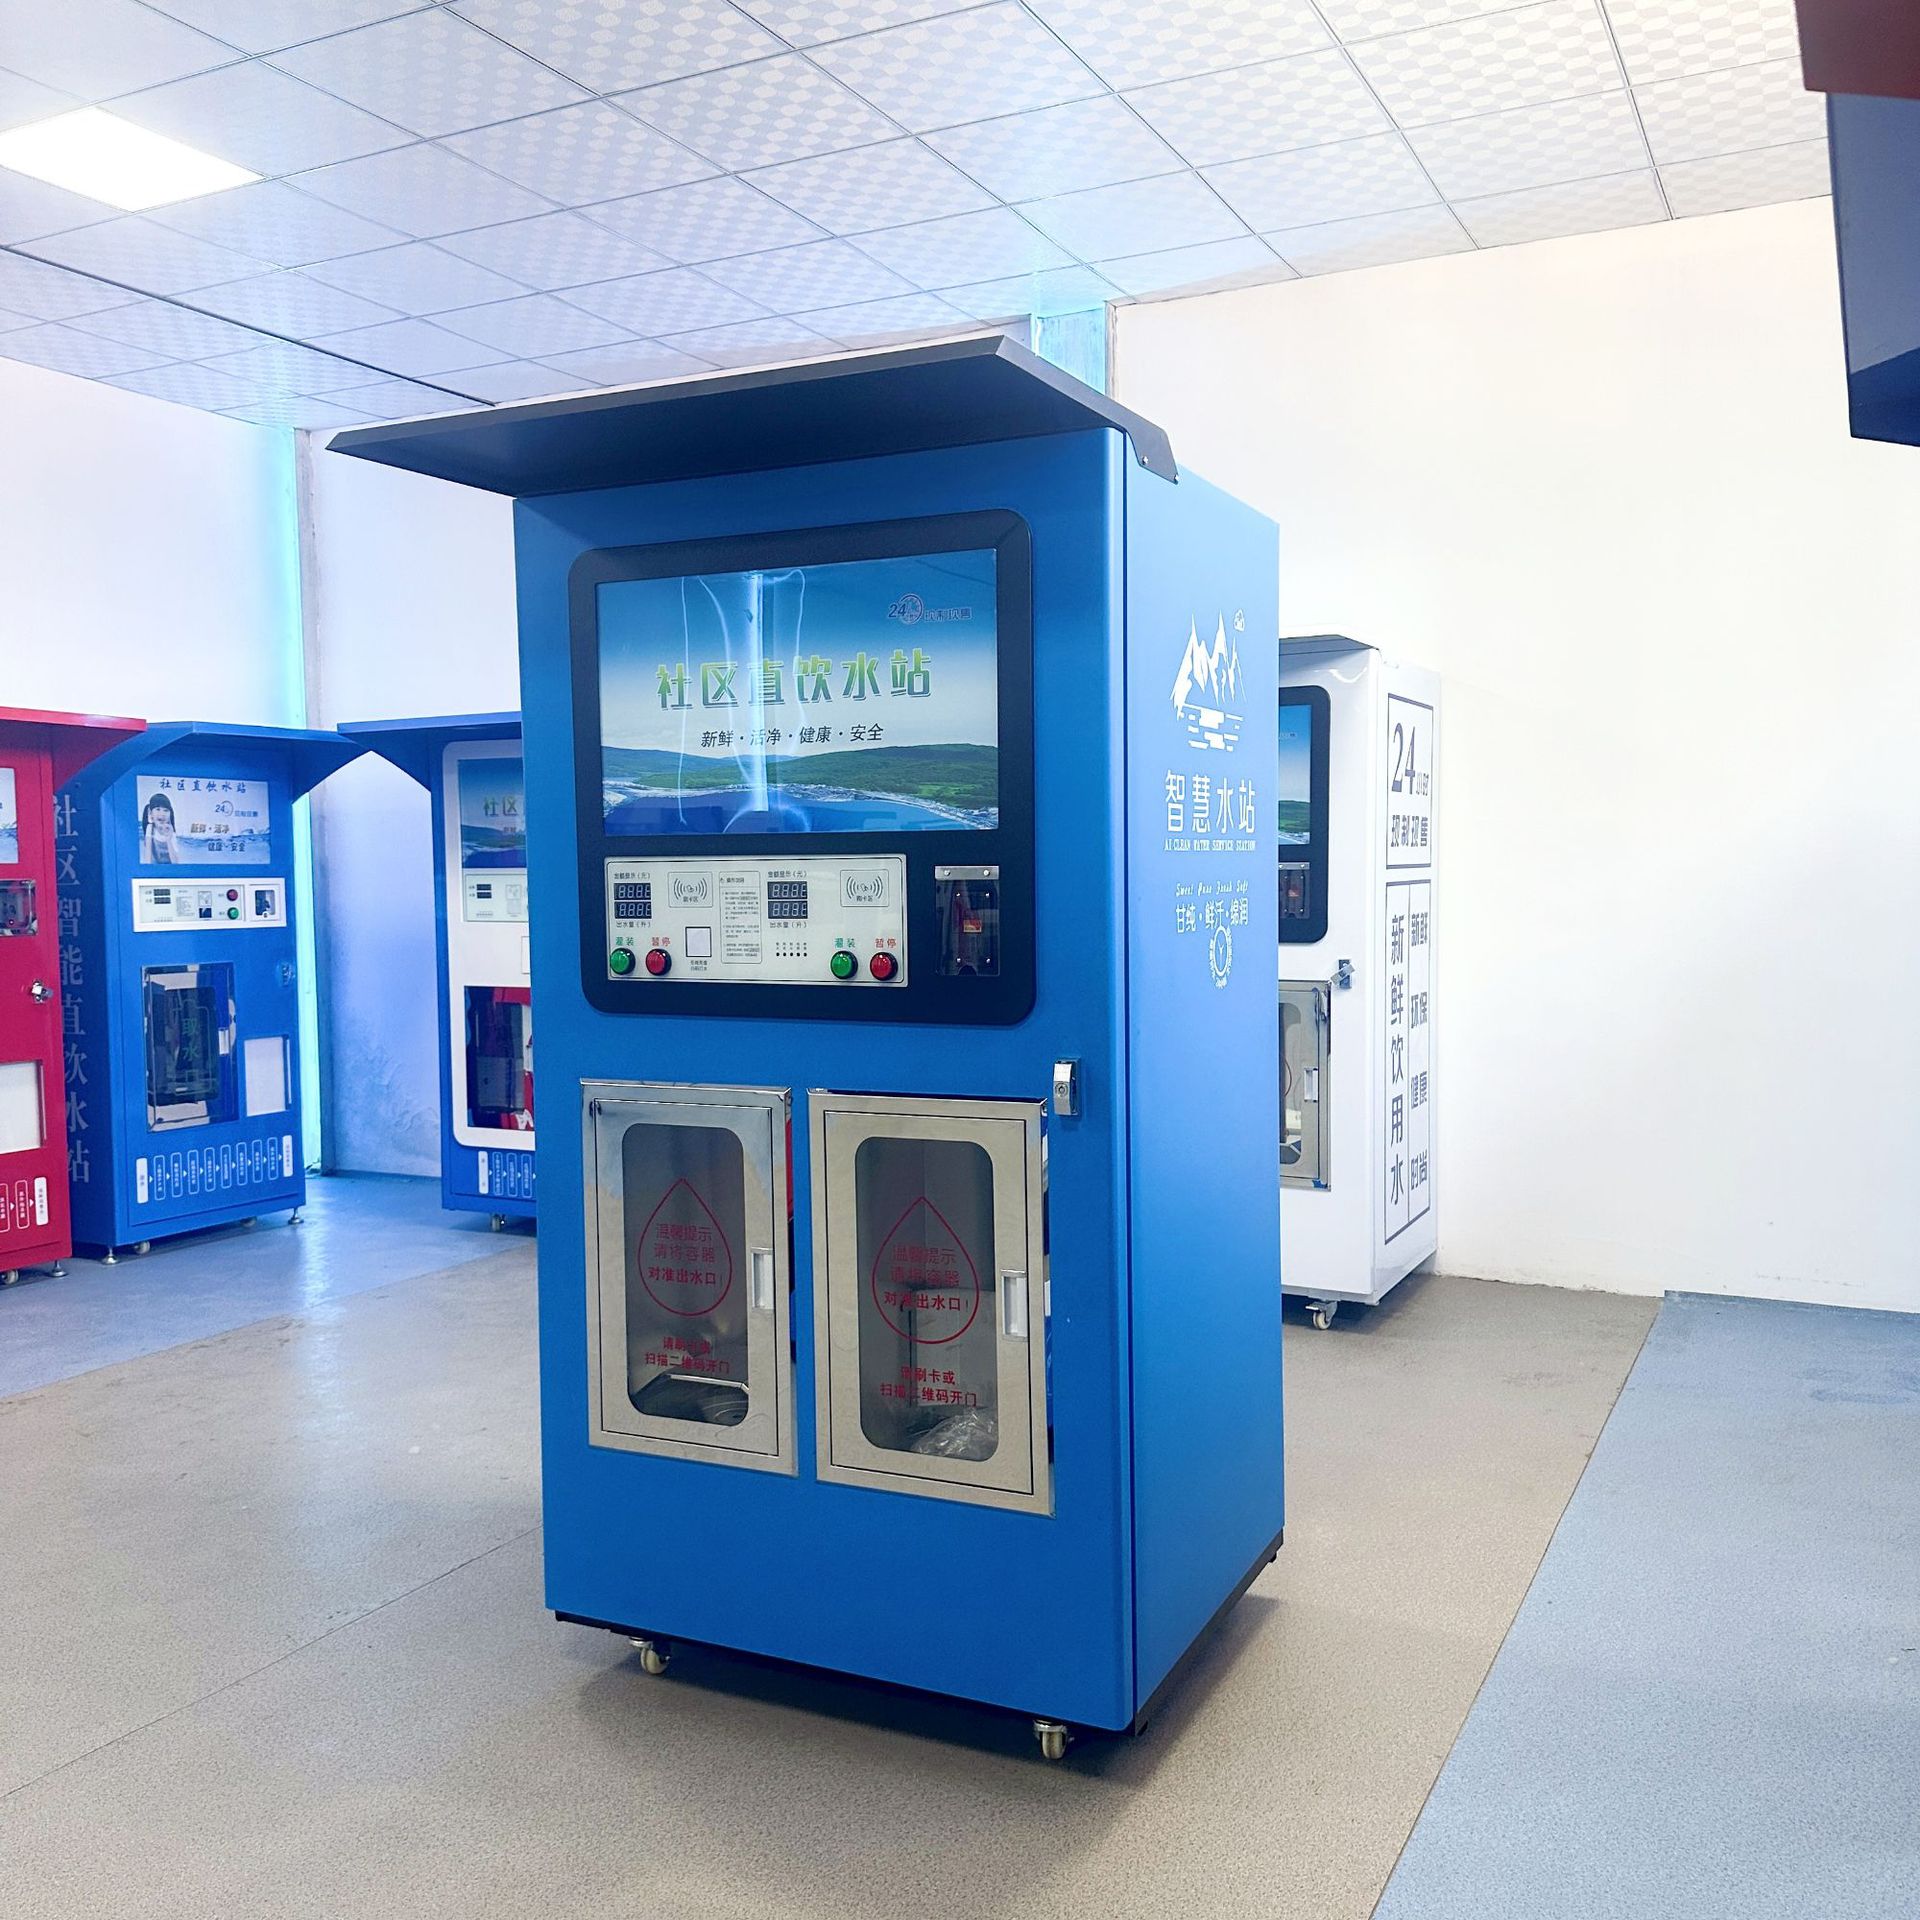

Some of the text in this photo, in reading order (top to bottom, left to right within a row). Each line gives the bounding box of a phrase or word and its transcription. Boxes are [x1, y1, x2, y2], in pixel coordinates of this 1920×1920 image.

[656, 648, 931, 710] 社区直饮水站
[1165, 769, 1256, 834] 智慧水站
[1411, 991, 1428, 1029] 环保
[1390, 914, 1405, 1206] 新鲜饮用水
